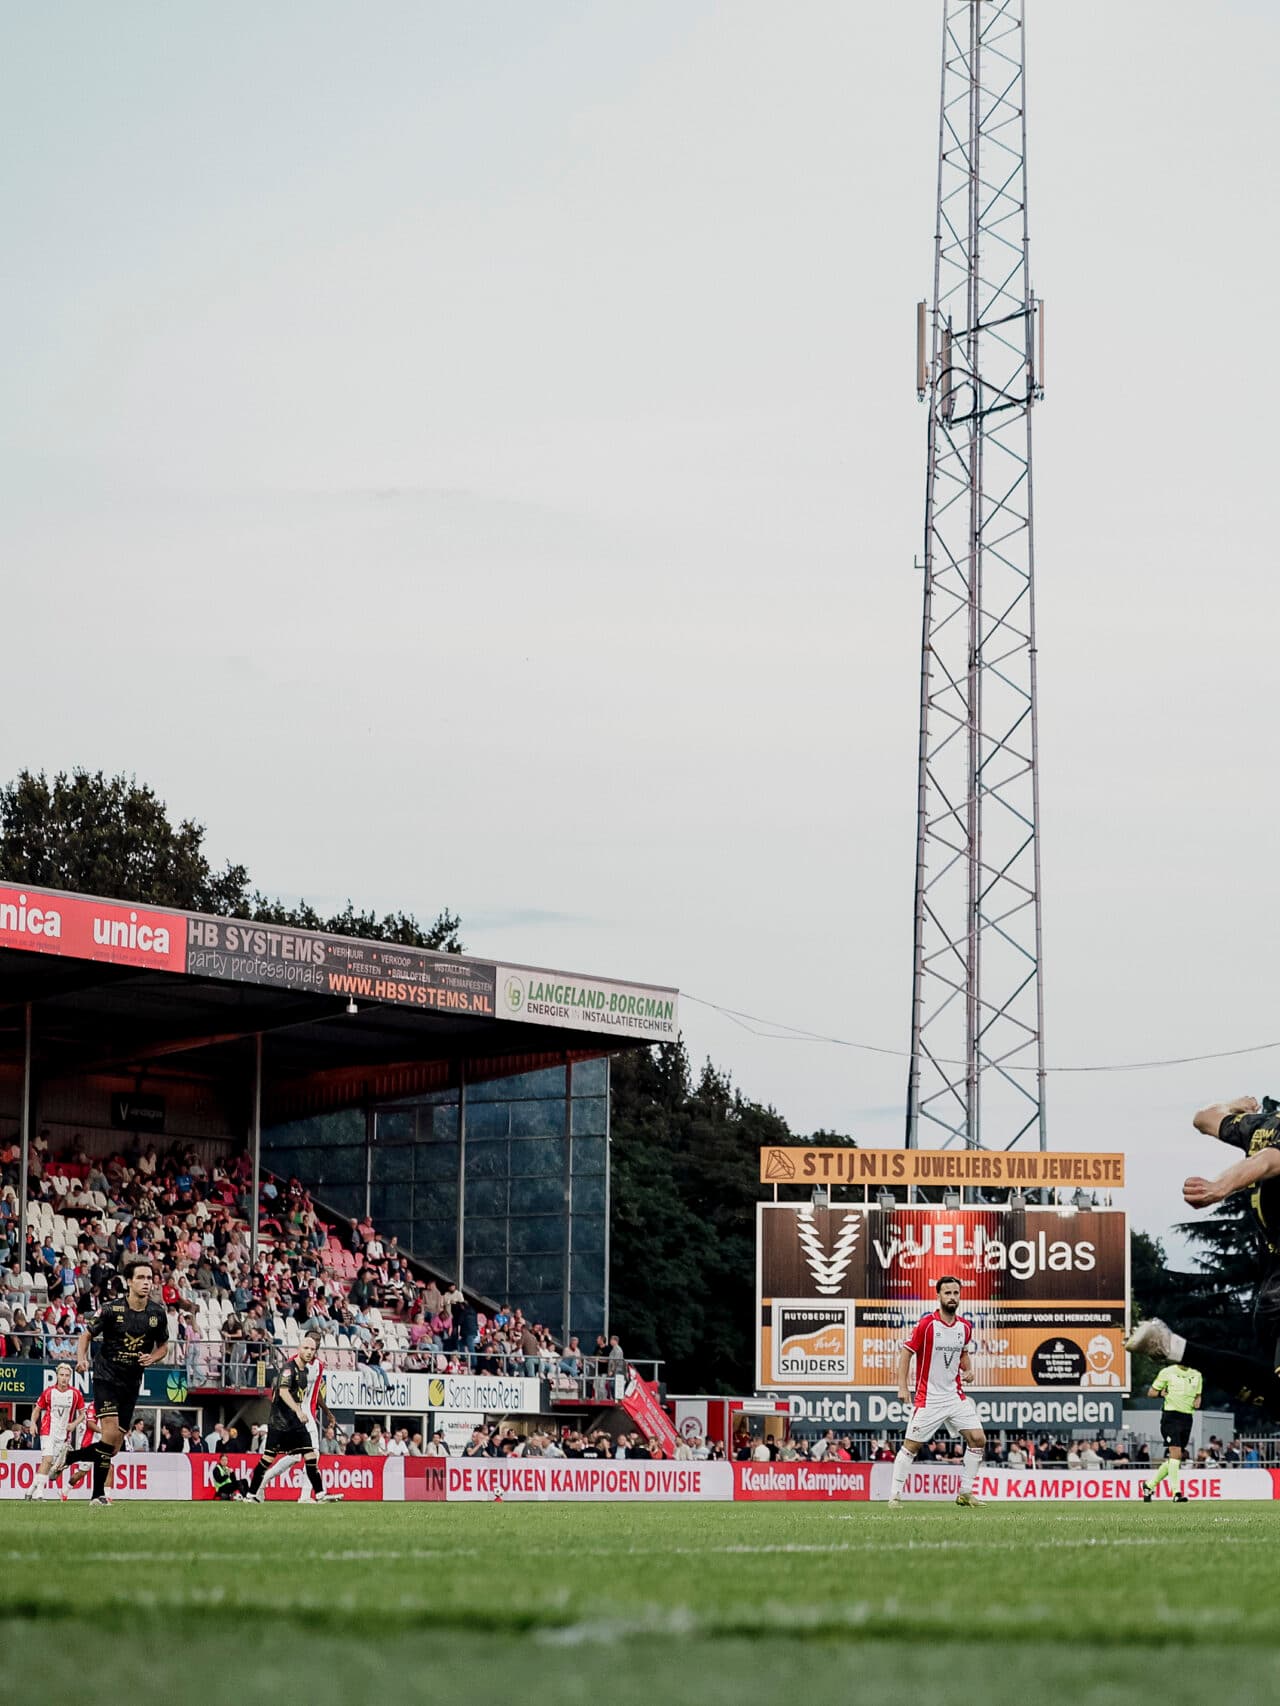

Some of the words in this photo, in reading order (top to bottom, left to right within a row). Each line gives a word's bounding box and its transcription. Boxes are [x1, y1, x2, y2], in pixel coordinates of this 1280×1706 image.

[93, 911, 170, 954] unica
[188, 920, 218, 948] HB
[226, 928, 326, 965] SYSTEMS
[188, 950, 228, 976] party
[231, 956, 324, 985] professionals
[332, 946, 364, 960] VERHUUR
[381, 953, 412, 967] VERKOOP
[352, 964, 382, 975] FEESTEN
[328, 973, 493, 1013] WWW.HBSYSTEMS.NL
[527, 1003, 570, 1018] ENERGIEK
[582, 1010, 673, 1033] INSTALLATIETECHNIEK
[802, 1152, 906, 1182] STIJNIS
[913, 1156, 1001, 1179] JUWELIERS
[1006, 1157, 1038, 1180] VAN
[1042, 1157, 1121, 1181] JEWELSTE
[784, 1312, 843, 1323] AUTOBEDRIJF
[331, 1375, 355, 1405] Sens
[449, 1379, 471, 1408] Sens
[473, 1379, 525, 1409] InstoRetail
[788, 1394, 861, 1422] Dutch
[868, 1395, 913, 1422] Des
[425, 1467, 444, 1491] IN
[449, 1468, 473, 1492] DE
[477, 1468, 546, 1492] KEUKEN
[551, 1470, 640, 1493] KAMPIOEN
[645, 1469, 701, 1493] DIVISIE
[741, 1467, 797, 1491] Keuken
[797, 1466, 865, 1492] Kampioen
[914, 1474, 930, 1494] DE
[1007, 1477, 1131, 1499] KAMPIOEN
